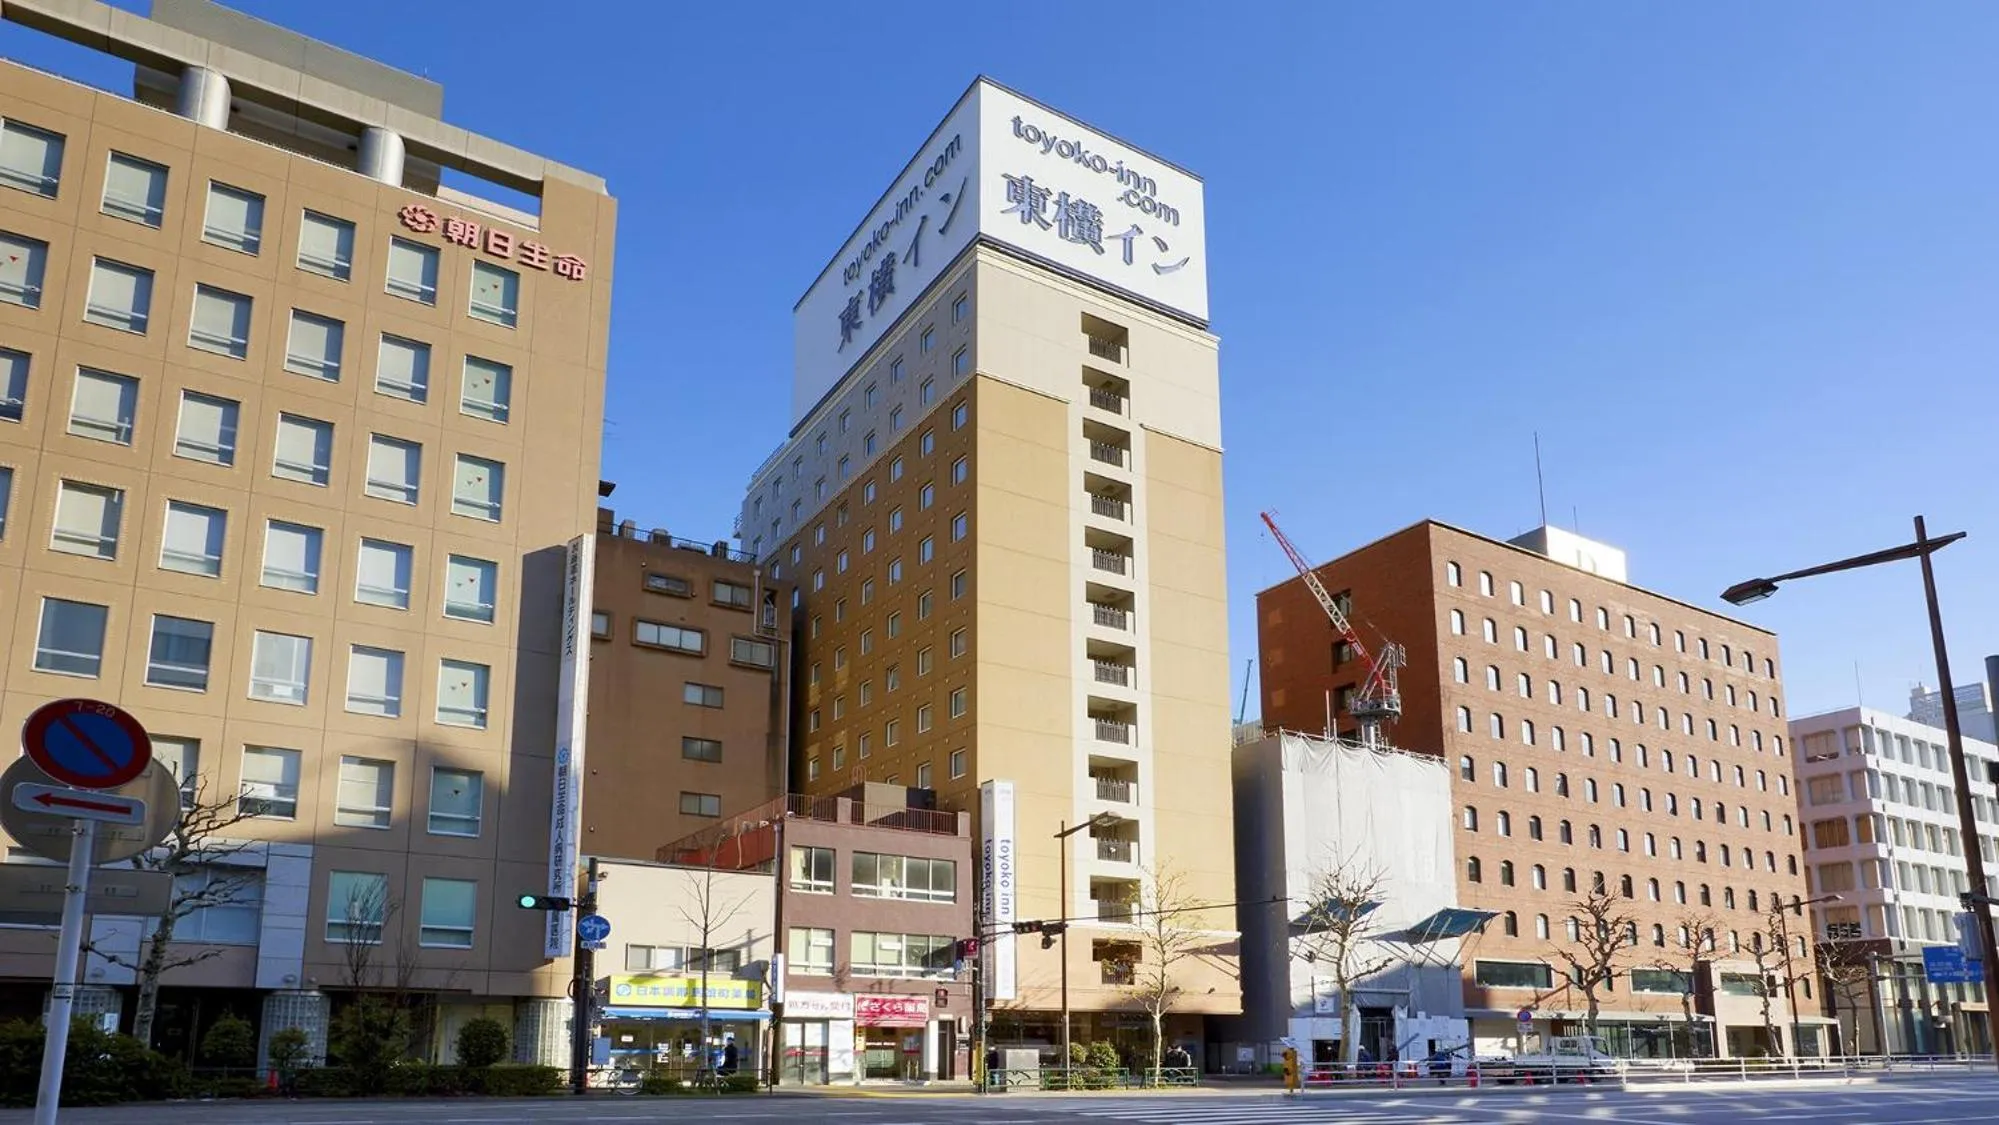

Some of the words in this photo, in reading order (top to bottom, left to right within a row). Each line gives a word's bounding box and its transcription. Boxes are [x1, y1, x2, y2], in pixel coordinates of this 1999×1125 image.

[1012, 114, 1157, 196] toyoko-inn
[843, 133, 962, 286] toyoko-inn.com
[1000, 173, 1190, 276] 東横イン
[1117, 190, 1180, 226] .com
[443, 217, 587, 281] 朝日生命
[837, 176, 968, 353] 東横イン
[984, 839, 993, 888] toyoko
[997, 839, 1012, 888] toyoko
[1000, 892, 1012, 915] inn
